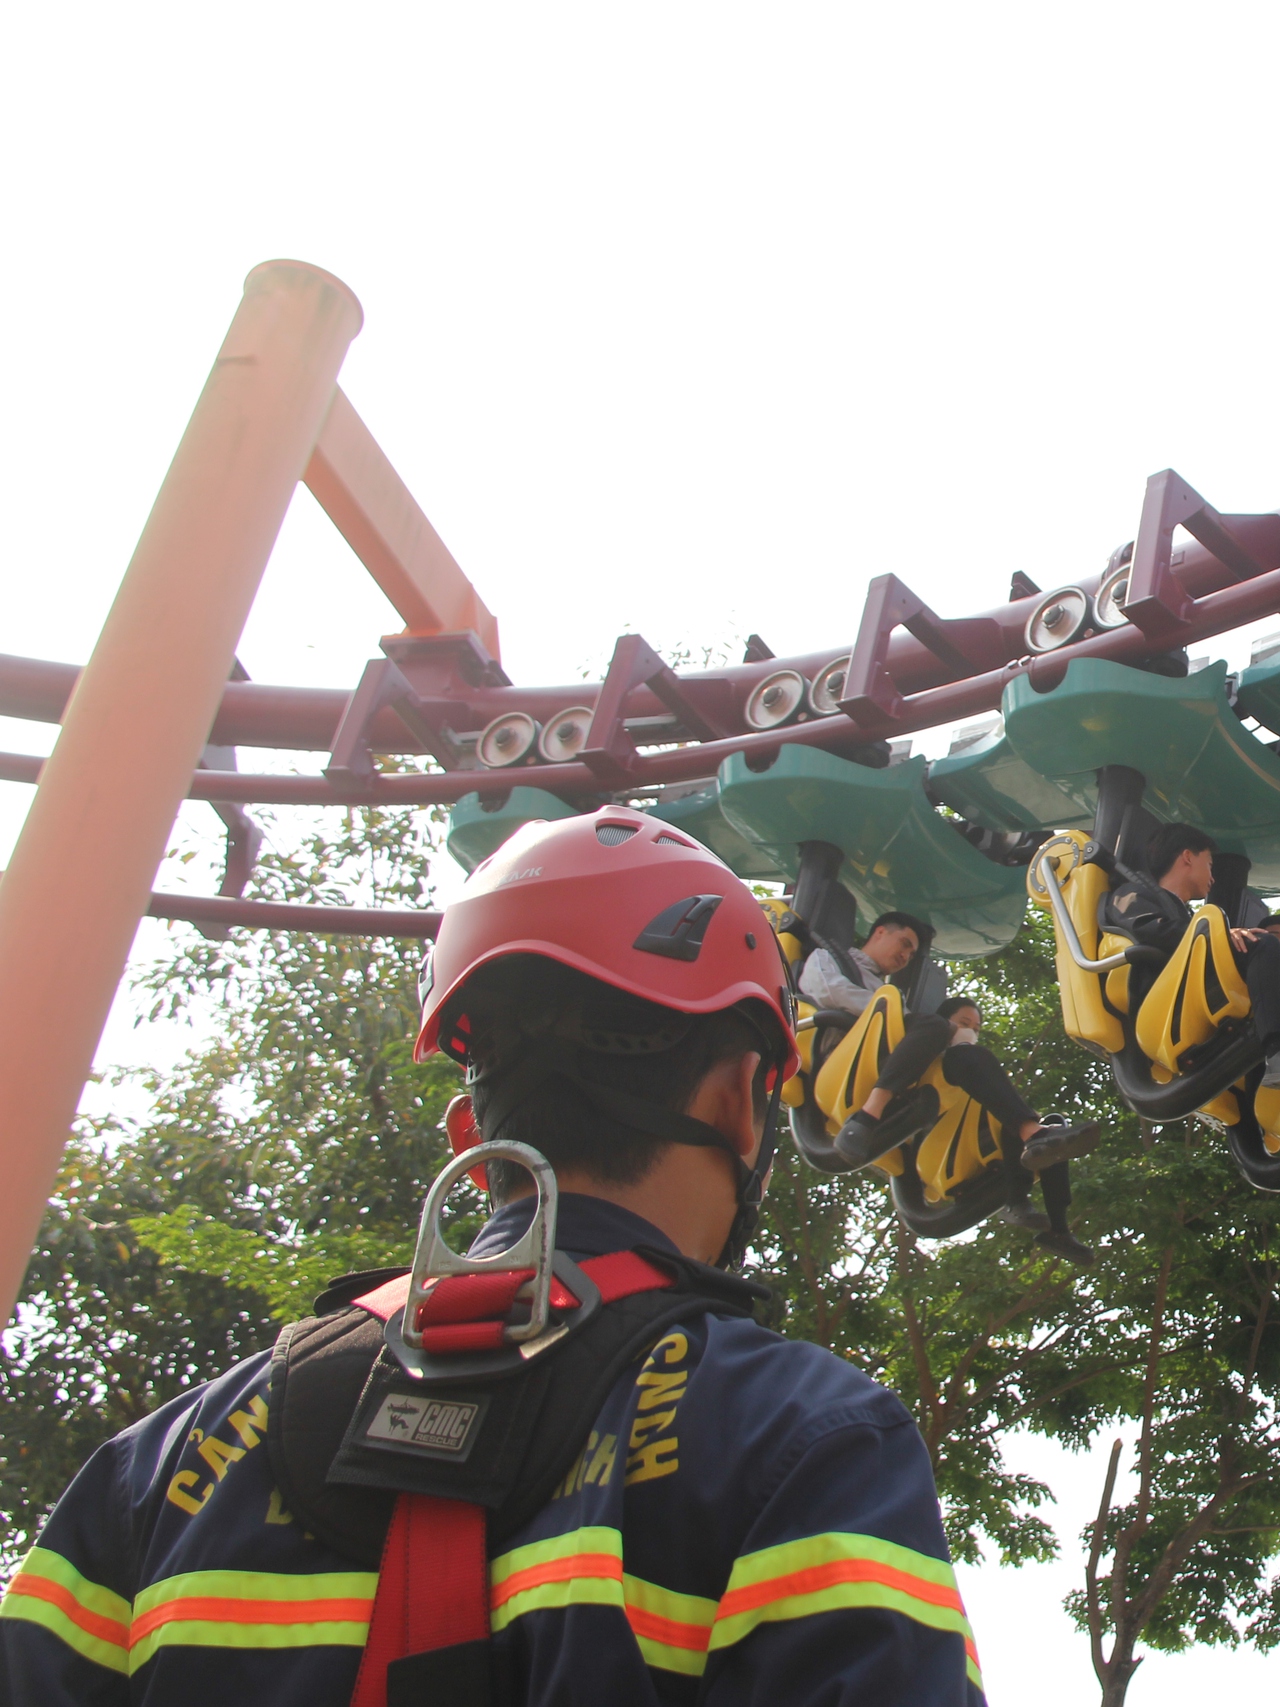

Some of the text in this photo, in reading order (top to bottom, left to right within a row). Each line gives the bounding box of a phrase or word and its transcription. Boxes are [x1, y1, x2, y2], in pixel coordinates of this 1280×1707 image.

[419, 1404, 472, 1438] CMC
[166, 1382, 273, 1516] CẢN
[415, 1434, 458, 1446] RESCUE
